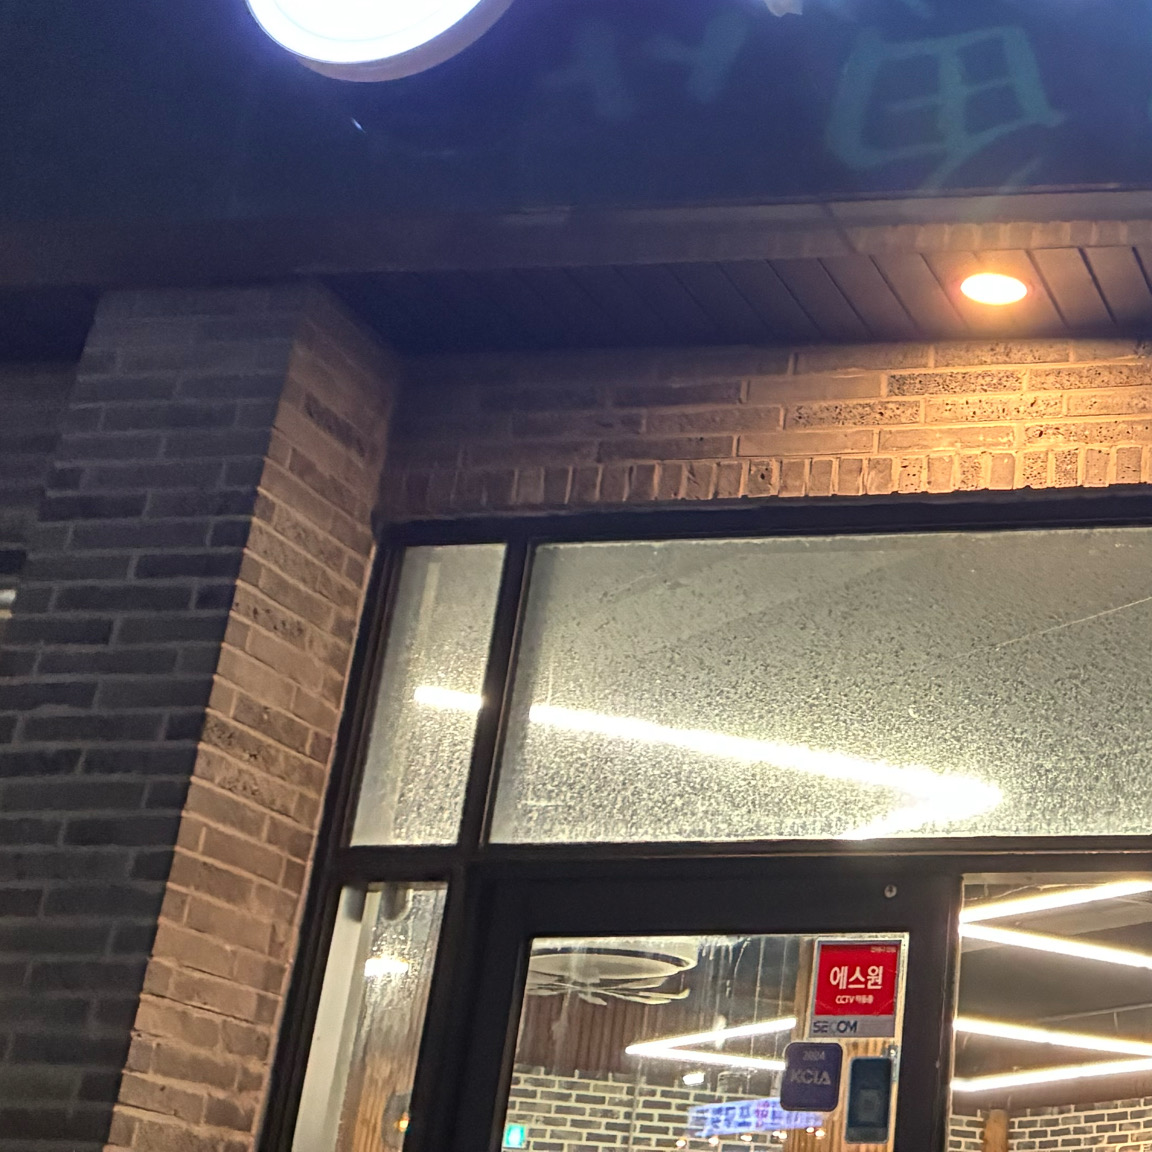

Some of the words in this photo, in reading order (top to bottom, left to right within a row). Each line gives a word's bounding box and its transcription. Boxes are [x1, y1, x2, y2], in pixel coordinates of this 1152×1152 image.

[829, 965, 884, 990] 에스원
[835, 994, 855, 1005] CCTV
[813, 1020, 858, 1034] SECOM
